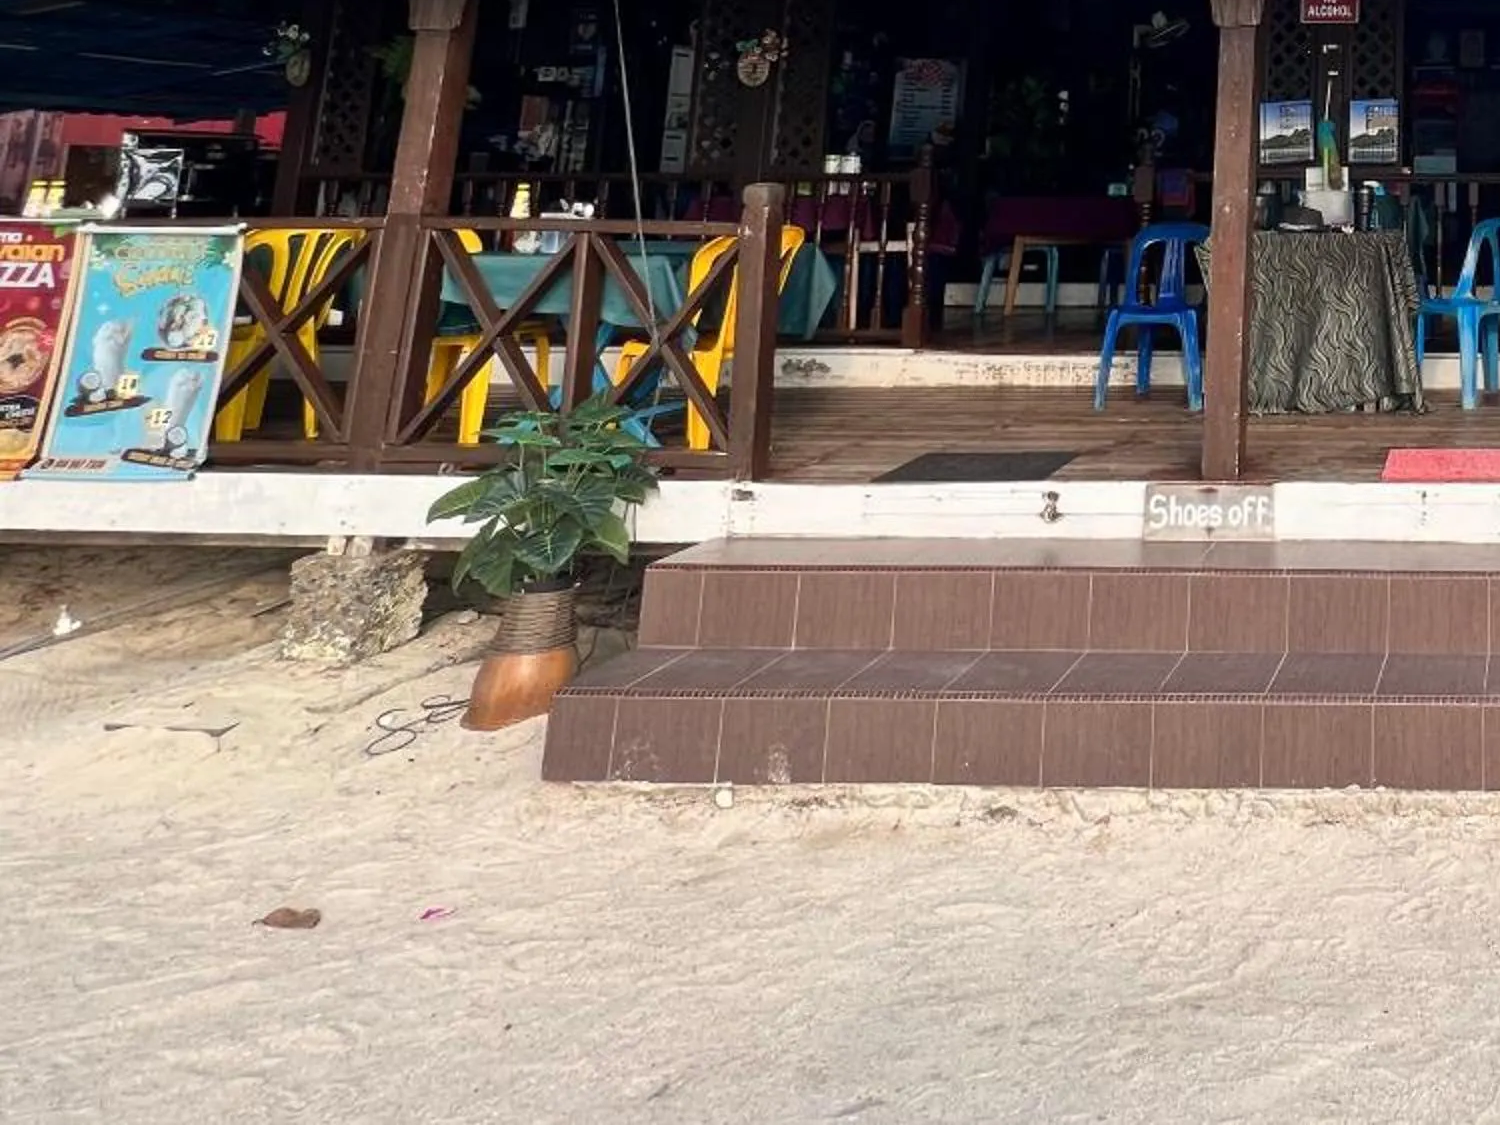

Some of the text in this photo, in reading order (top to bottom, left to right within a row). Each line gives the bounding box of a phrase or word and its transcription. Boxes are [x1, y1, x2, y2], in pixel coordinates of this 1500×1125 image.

[1307, 5, 1353, 17] ALCOHOL
[1149, 494, 1270, 530] Shoes off
